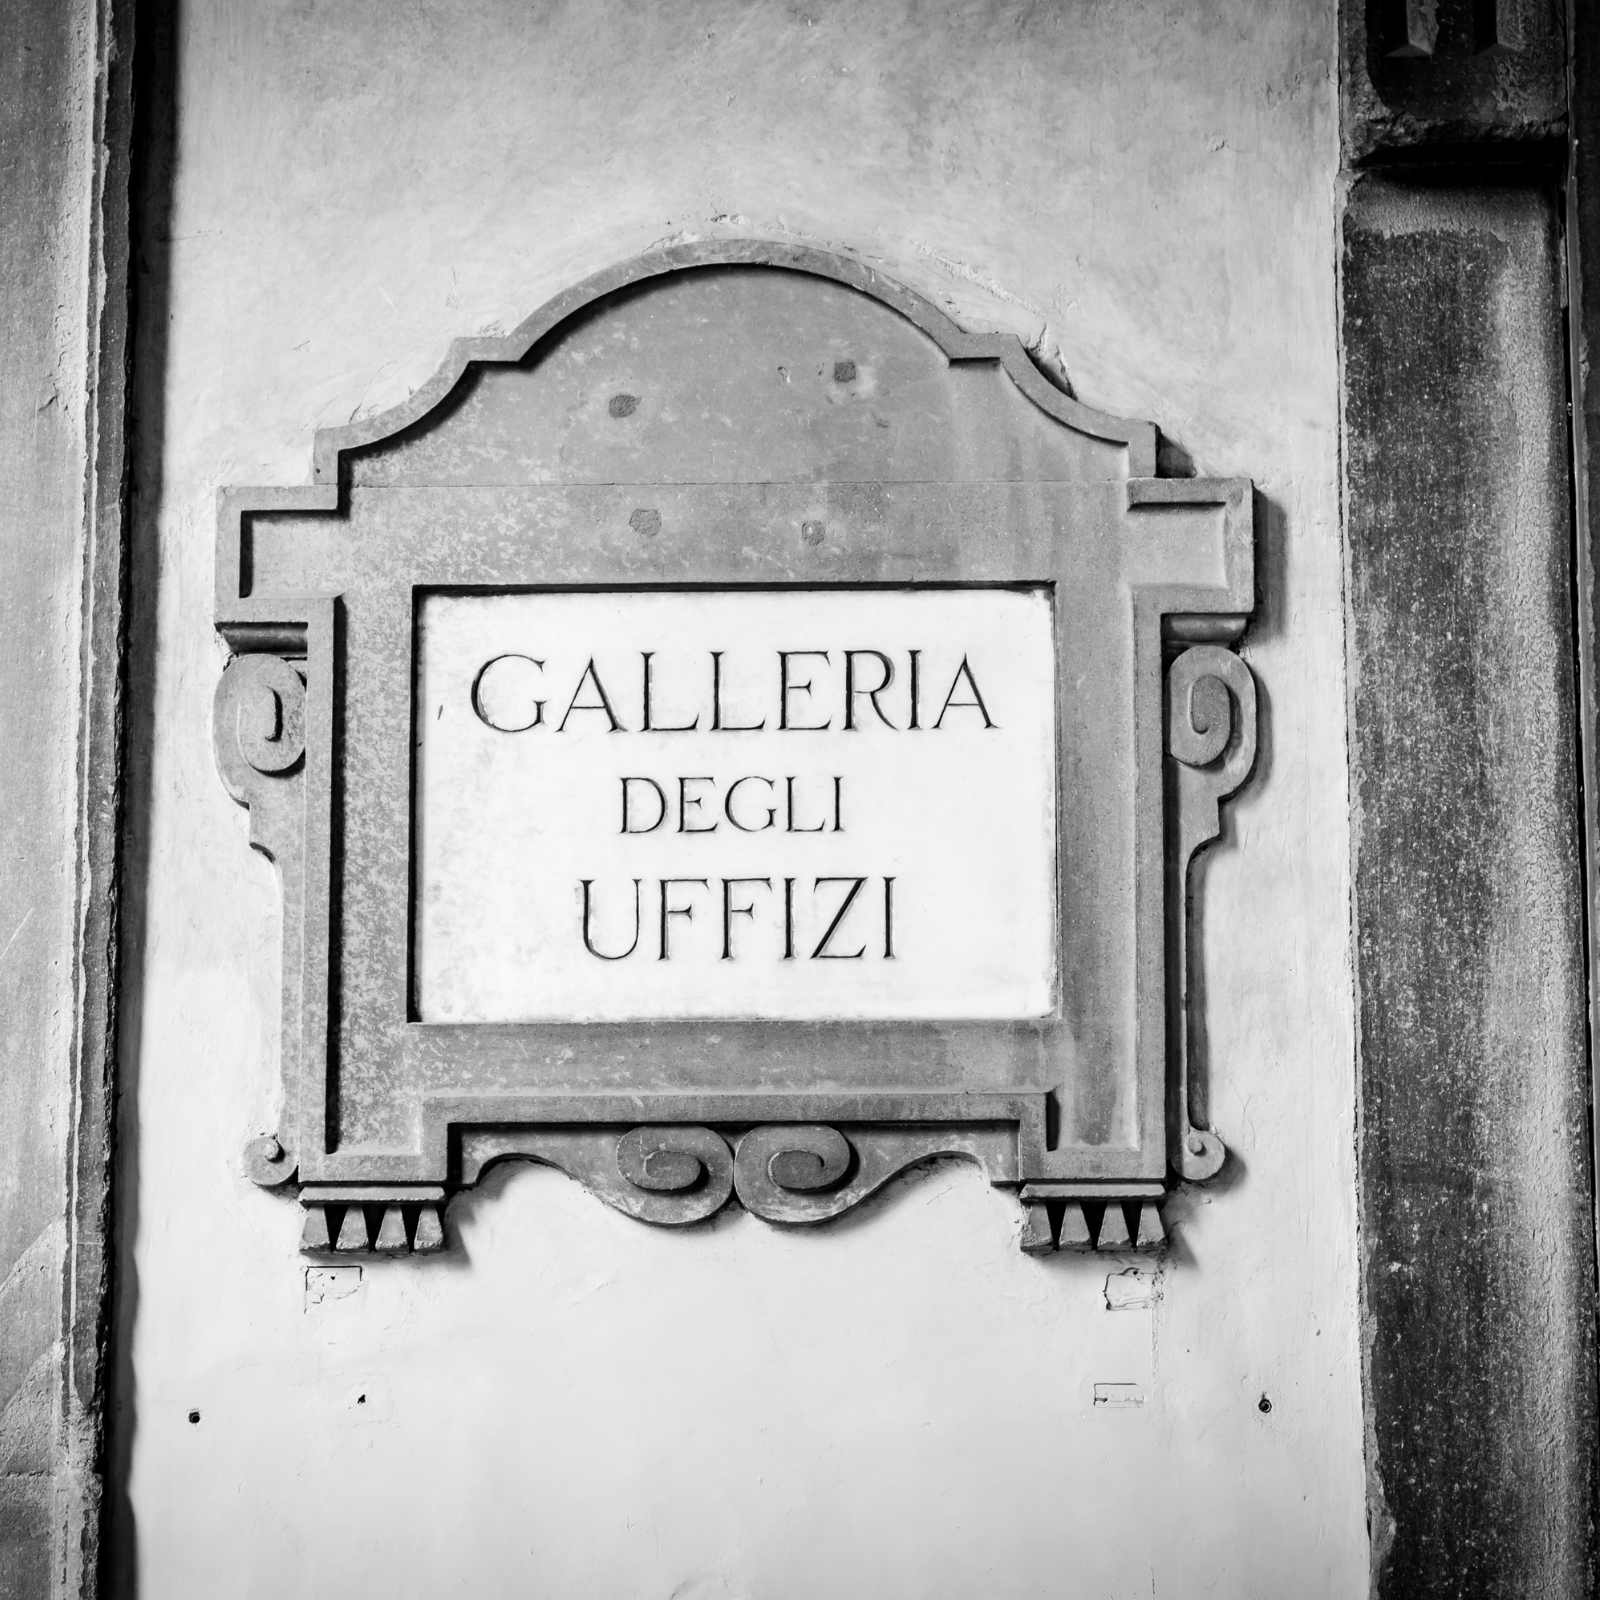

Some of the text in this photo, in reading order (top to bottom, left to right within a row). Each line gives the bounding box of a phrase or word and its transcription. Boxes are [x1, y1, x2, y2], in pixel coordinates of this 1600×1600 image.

[470, 650, 1002, 733] GALLERIA
[620, 776, 845, 834] DEGLI
[580, 876, 899, 961] UFFIZI
